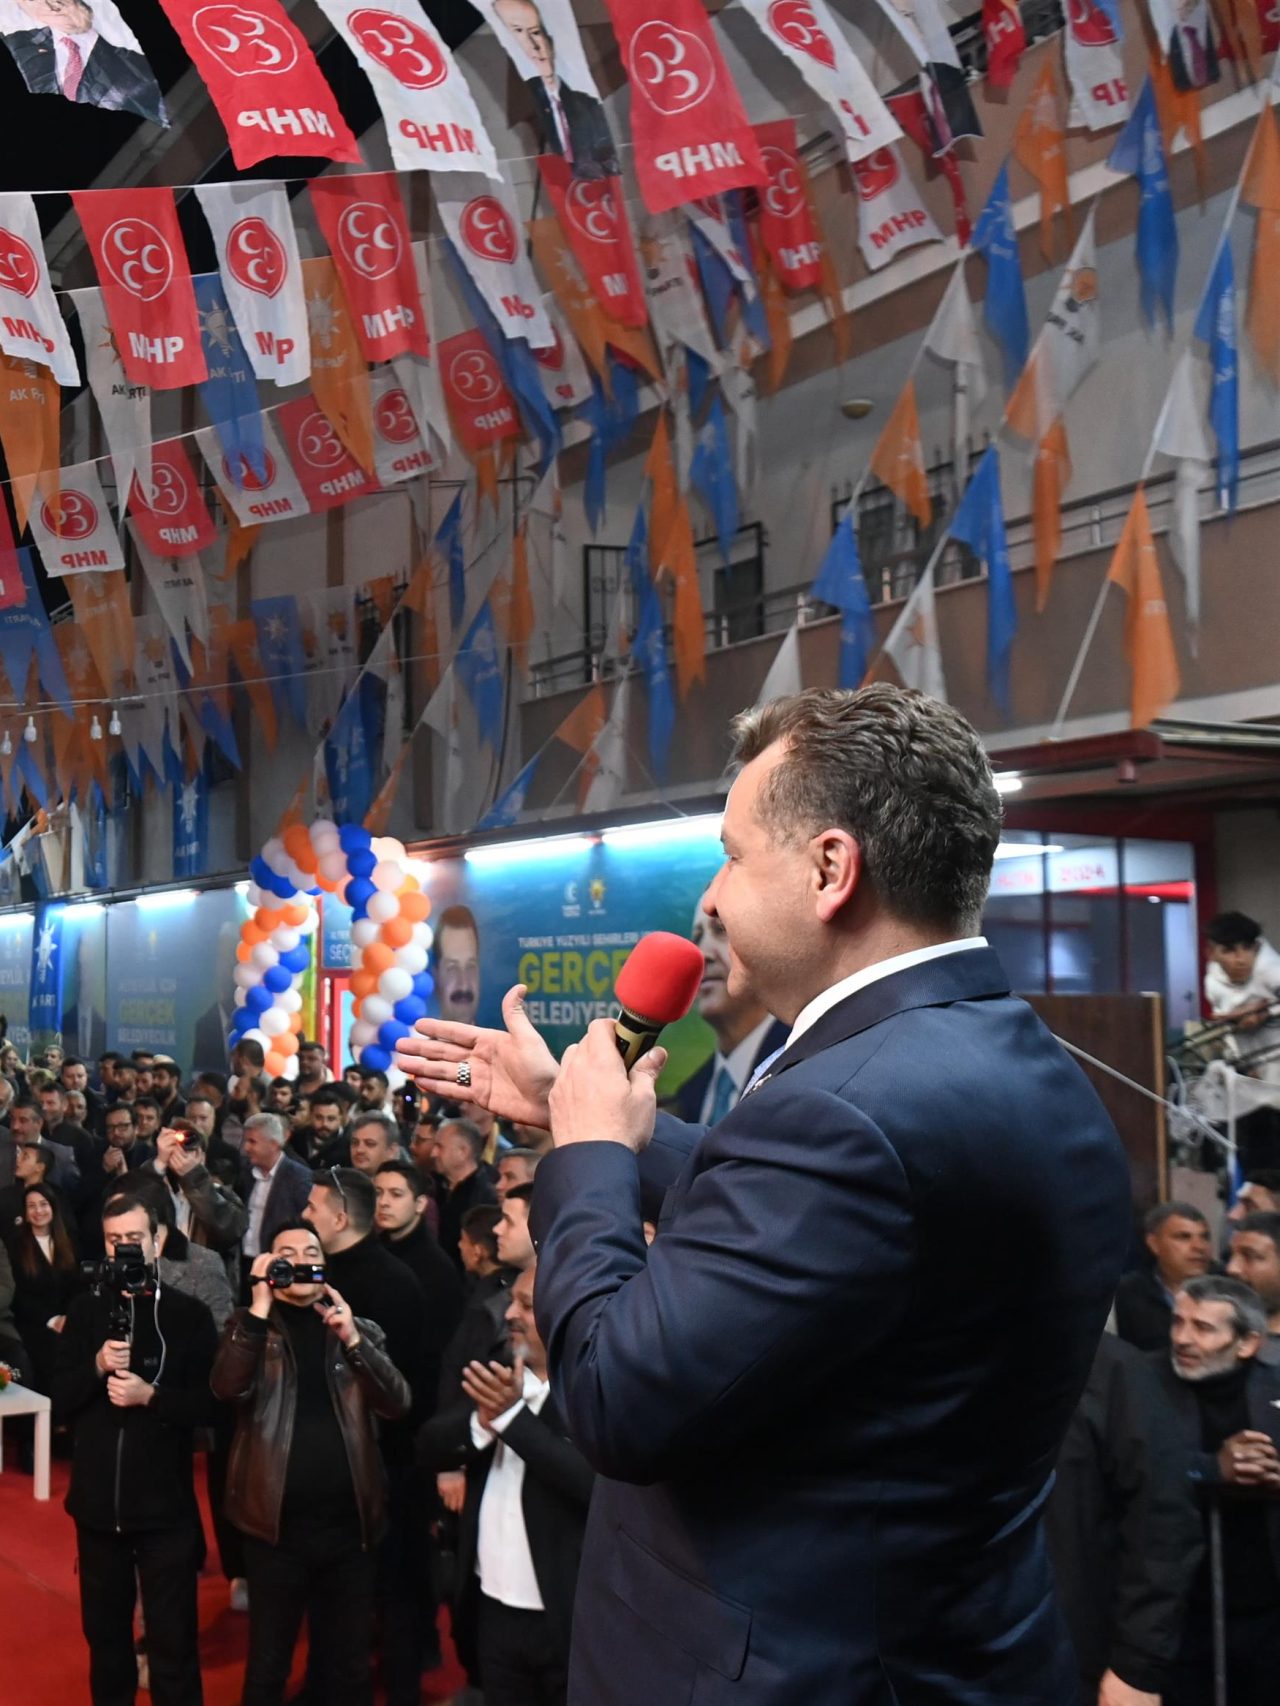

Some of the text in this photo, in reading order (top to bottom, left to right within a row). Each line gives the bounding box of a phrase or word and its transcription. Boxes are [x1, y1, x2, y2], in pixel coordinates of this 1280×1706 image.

[870, 209, 927, 249] MHP
[361, 304, 415, 339] MHP
[127, 331, 185, 364] MHP
[9, 388, 28, 401] AK
